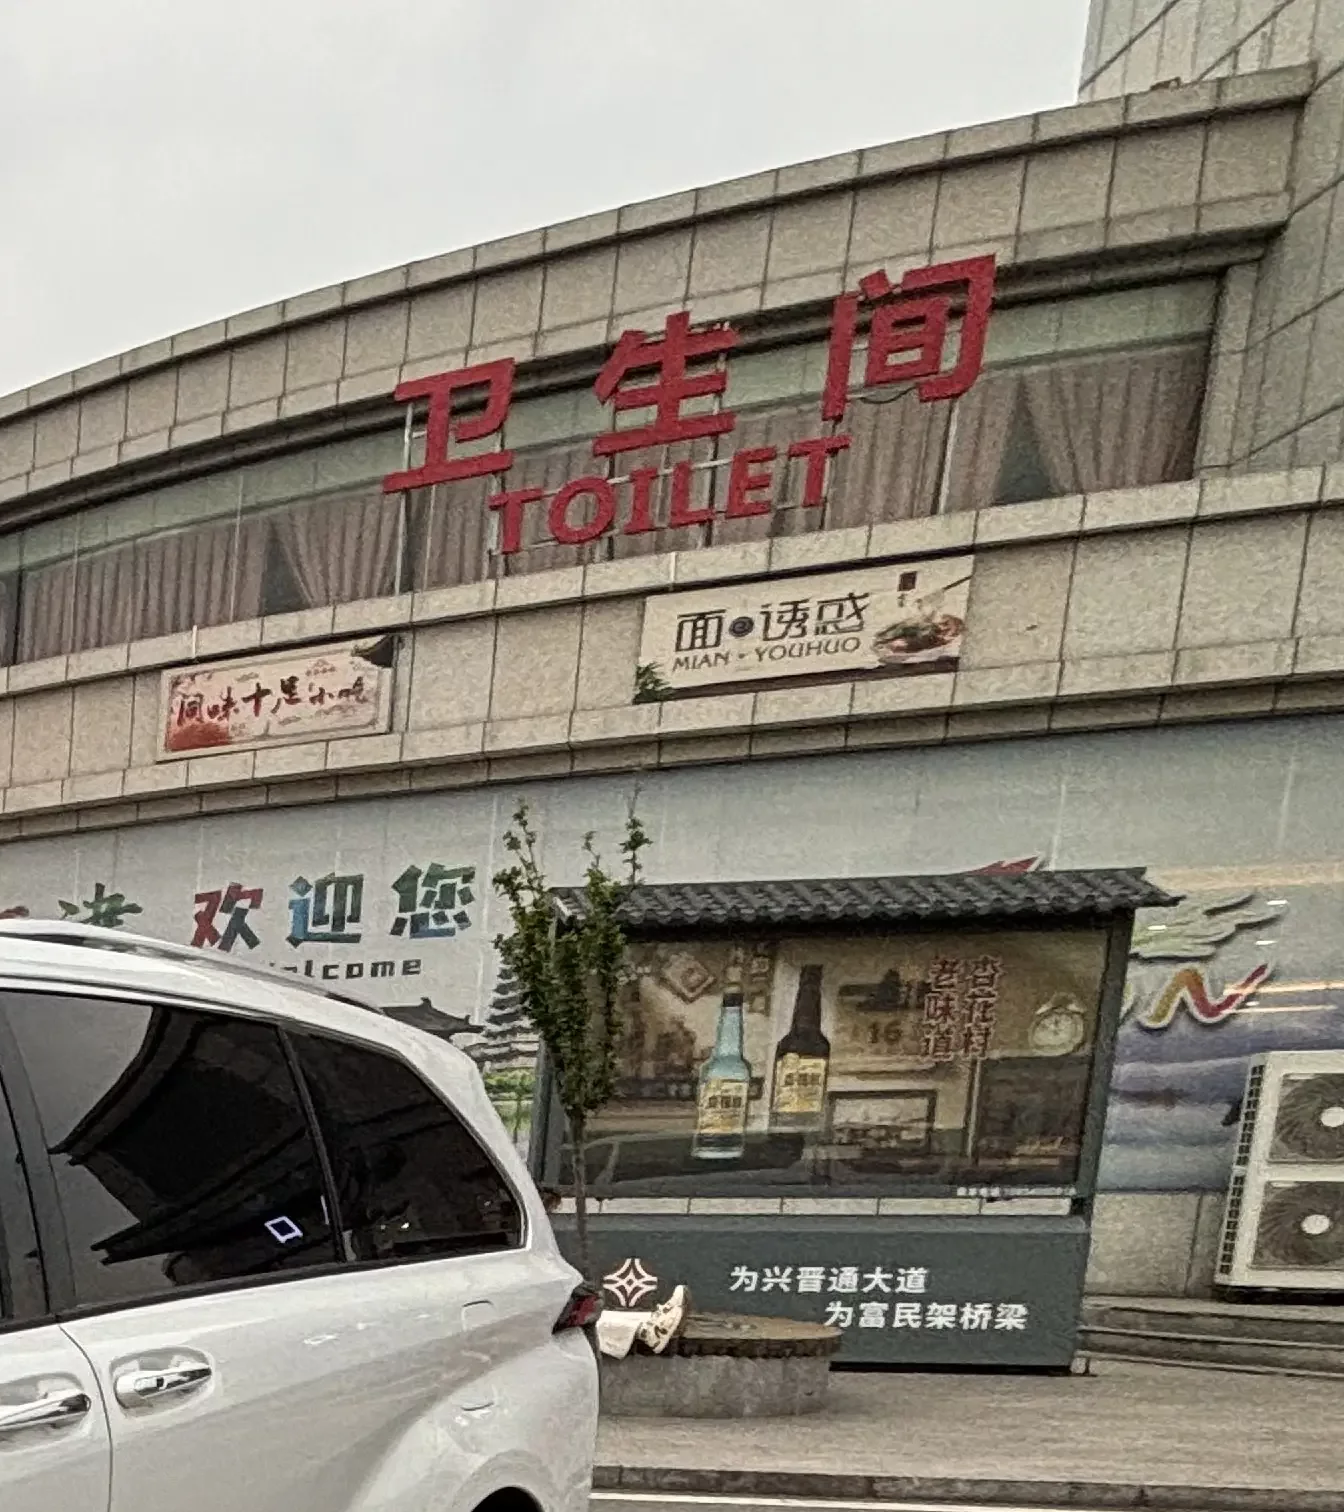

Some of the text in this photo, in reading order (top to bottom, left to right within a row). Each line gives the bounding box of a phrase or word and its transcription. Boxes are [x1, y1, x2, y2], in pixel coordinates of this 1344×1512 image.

[381, 254, 997, 495] 卫生间
[488, 434, 853, 556] TOILET
[759, 591, 871, 642] 诱惑
[671, 636, 861, 673] MIAN YOUHUO
[190, 862, 477, 953] 欢迎您
[268, 958, 422, 981] lcome
[728, 1265, 931, 1294] 为兴晋通大道
[823, 1300, 1030, 1331] 为富民架桥梁
